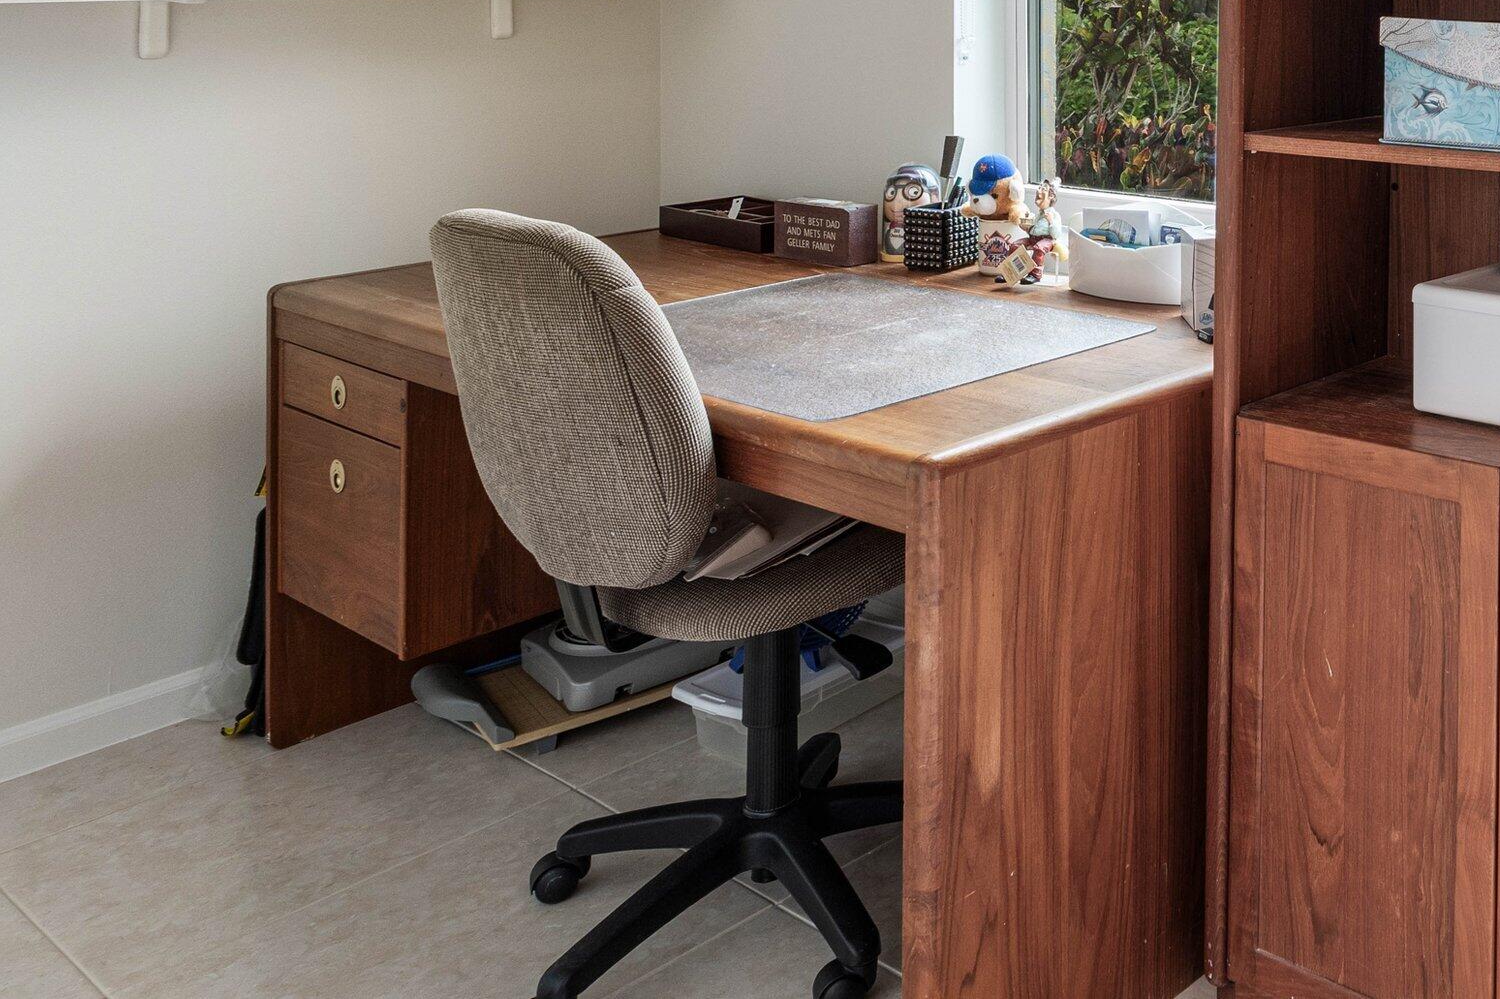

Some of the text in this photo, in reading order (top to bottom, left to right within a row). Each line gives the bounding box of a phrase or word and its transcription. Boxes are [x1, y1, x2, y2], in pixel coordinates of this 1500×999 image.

[783, 214, 840, 229] TO THE BEST DAD
[787, 227, 836, 240] AND METS FAN
[787, 238, 835, 252] GELLER FAMILY
